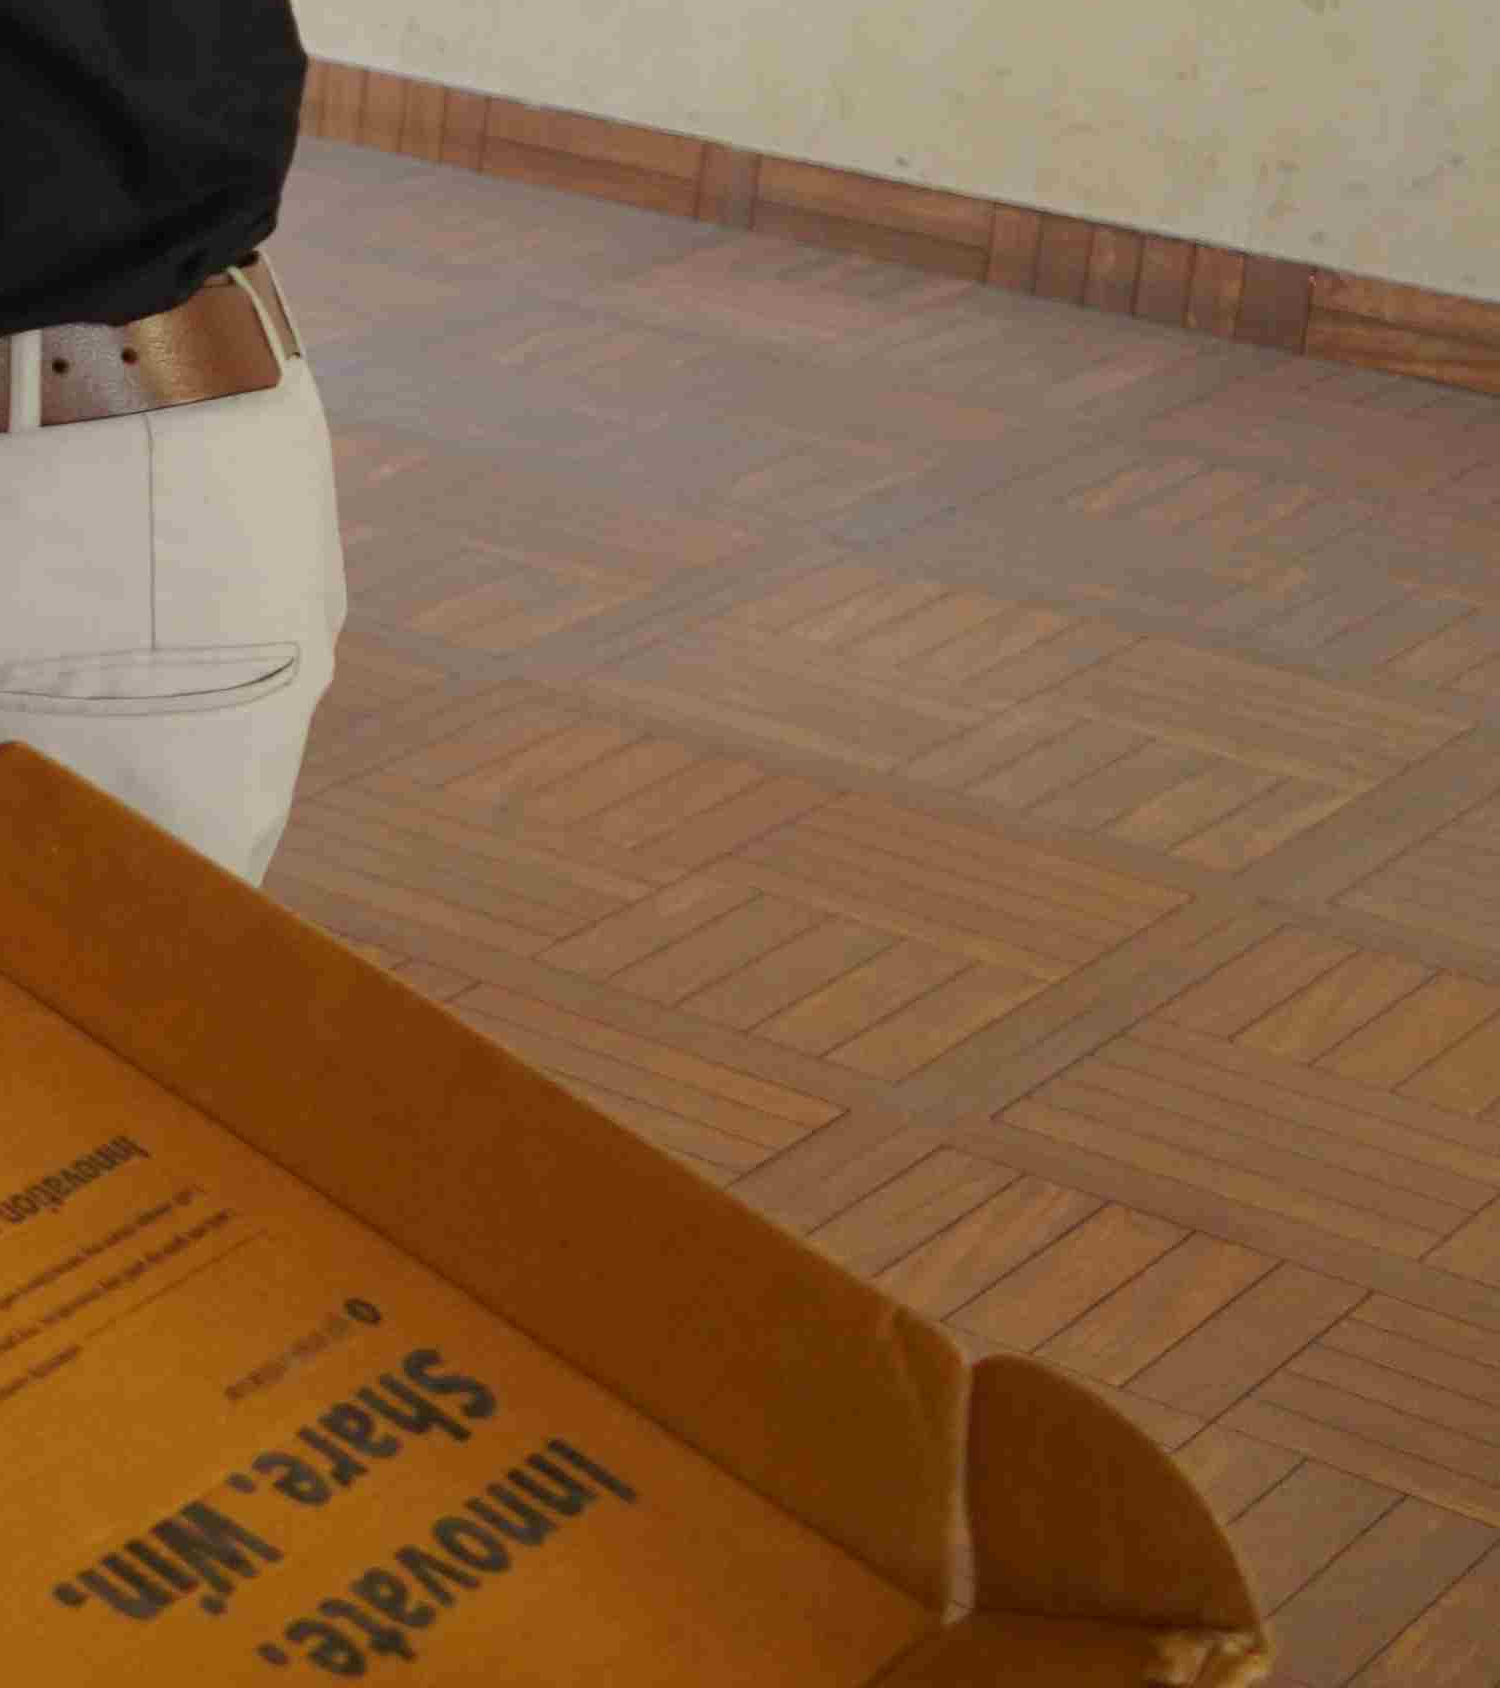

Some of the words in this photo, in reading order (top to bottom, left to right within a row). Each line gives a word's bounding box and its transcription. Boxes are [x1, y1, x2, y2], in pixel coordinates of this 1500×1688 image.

[226, 1347, 497, 1506] Share.
[51, 1498, 285, 1621] Win.
[256, 1437, 641, 1678] Innovate.
